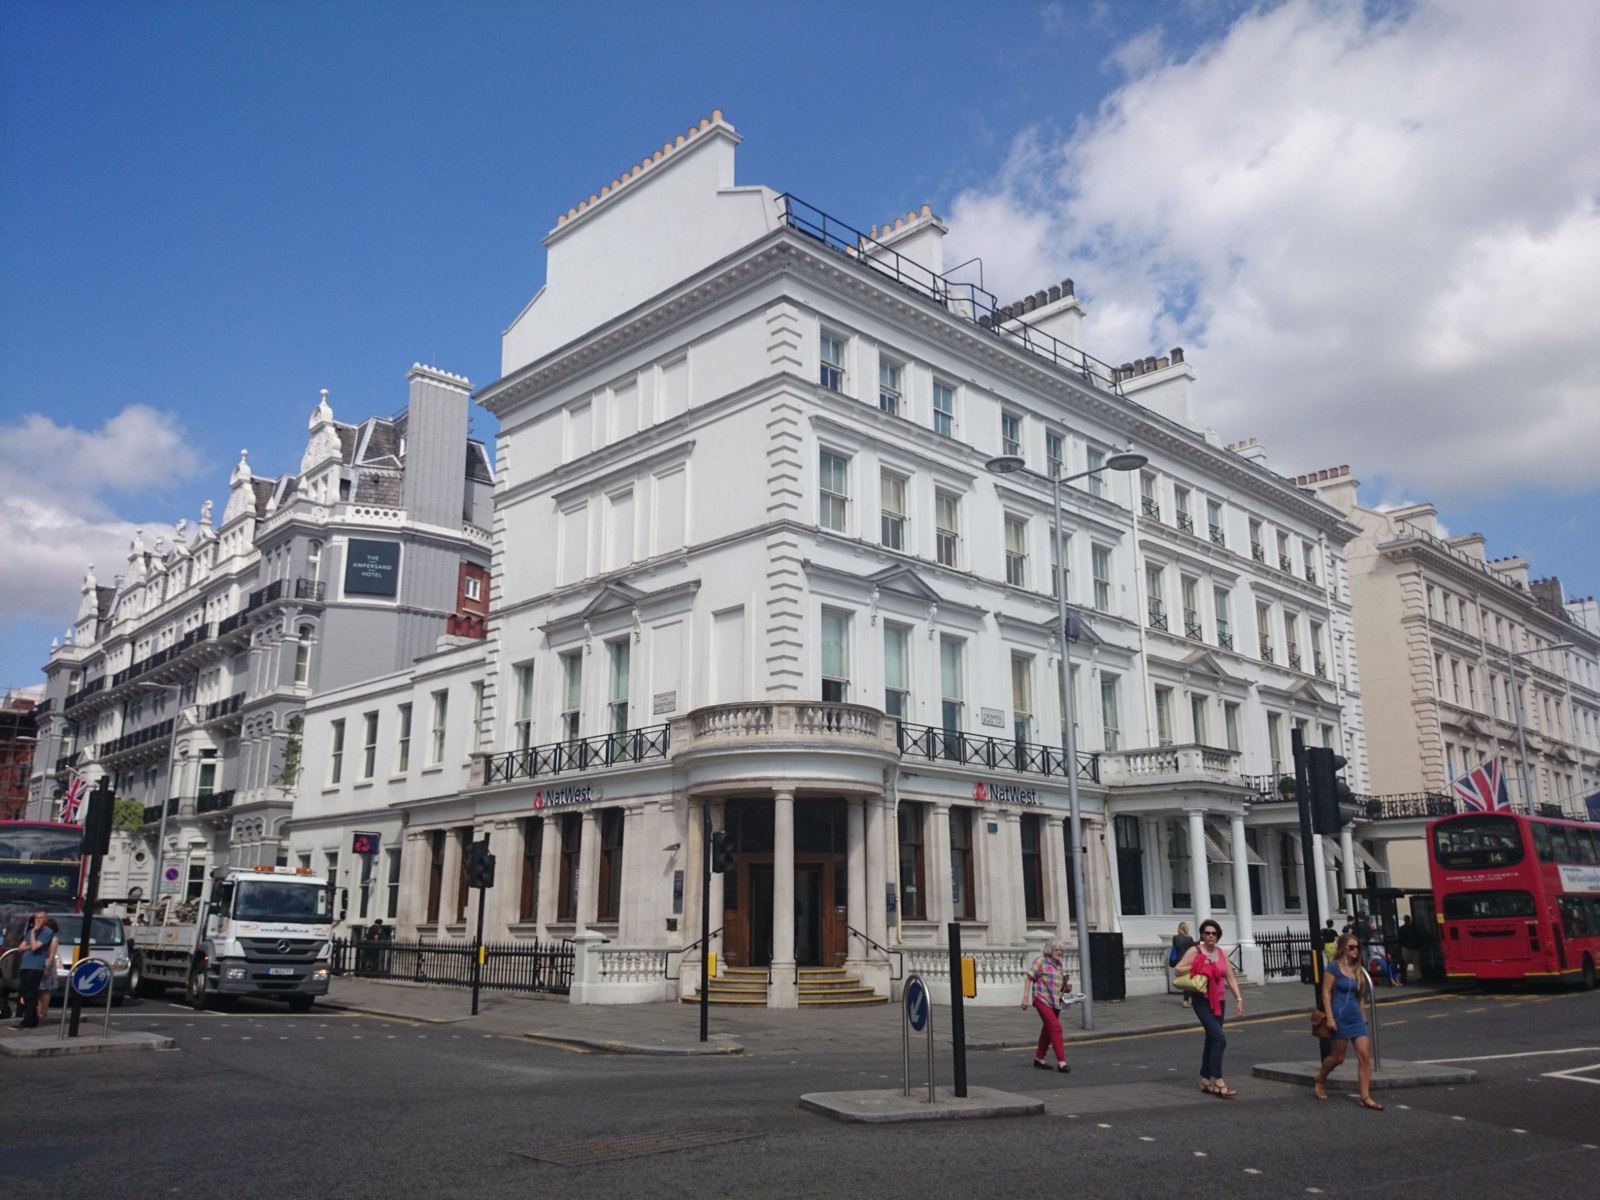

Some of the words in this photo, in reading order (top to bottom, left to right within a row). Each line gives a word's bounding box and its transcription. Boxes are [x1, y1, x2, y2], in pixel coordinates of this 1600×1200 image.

[353, 562, 392, 570] AMPERSAND
[546, 785, 592, 807] NatWest
[988, 783, 1037, 805] NatWest
[1490, 853, 1503, 862] 14
[49, 876, 67, 888] 345
